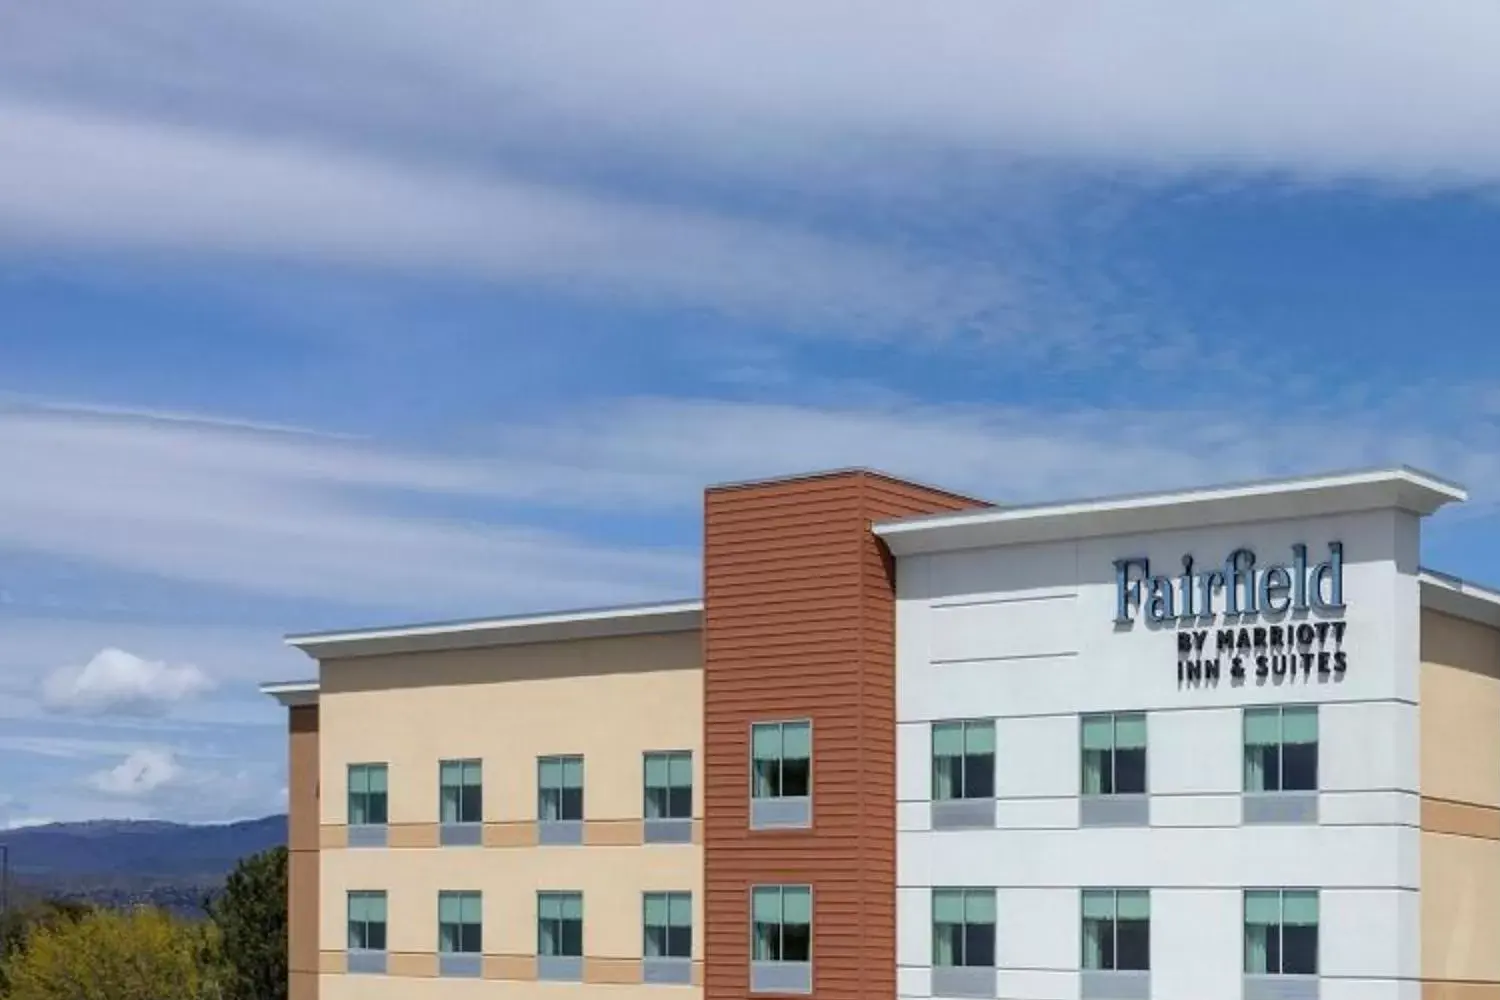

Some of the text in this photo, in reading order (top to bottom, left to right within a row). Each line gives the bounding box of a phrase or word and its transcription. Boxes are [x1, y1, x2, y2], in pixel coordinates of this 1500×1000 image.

[1112, 540, 1347, 624] Fairfield
[1177, 621, 1347, 652] BY MARRIOTT
[1177, 651, 1348, 681] INN & SUITES
